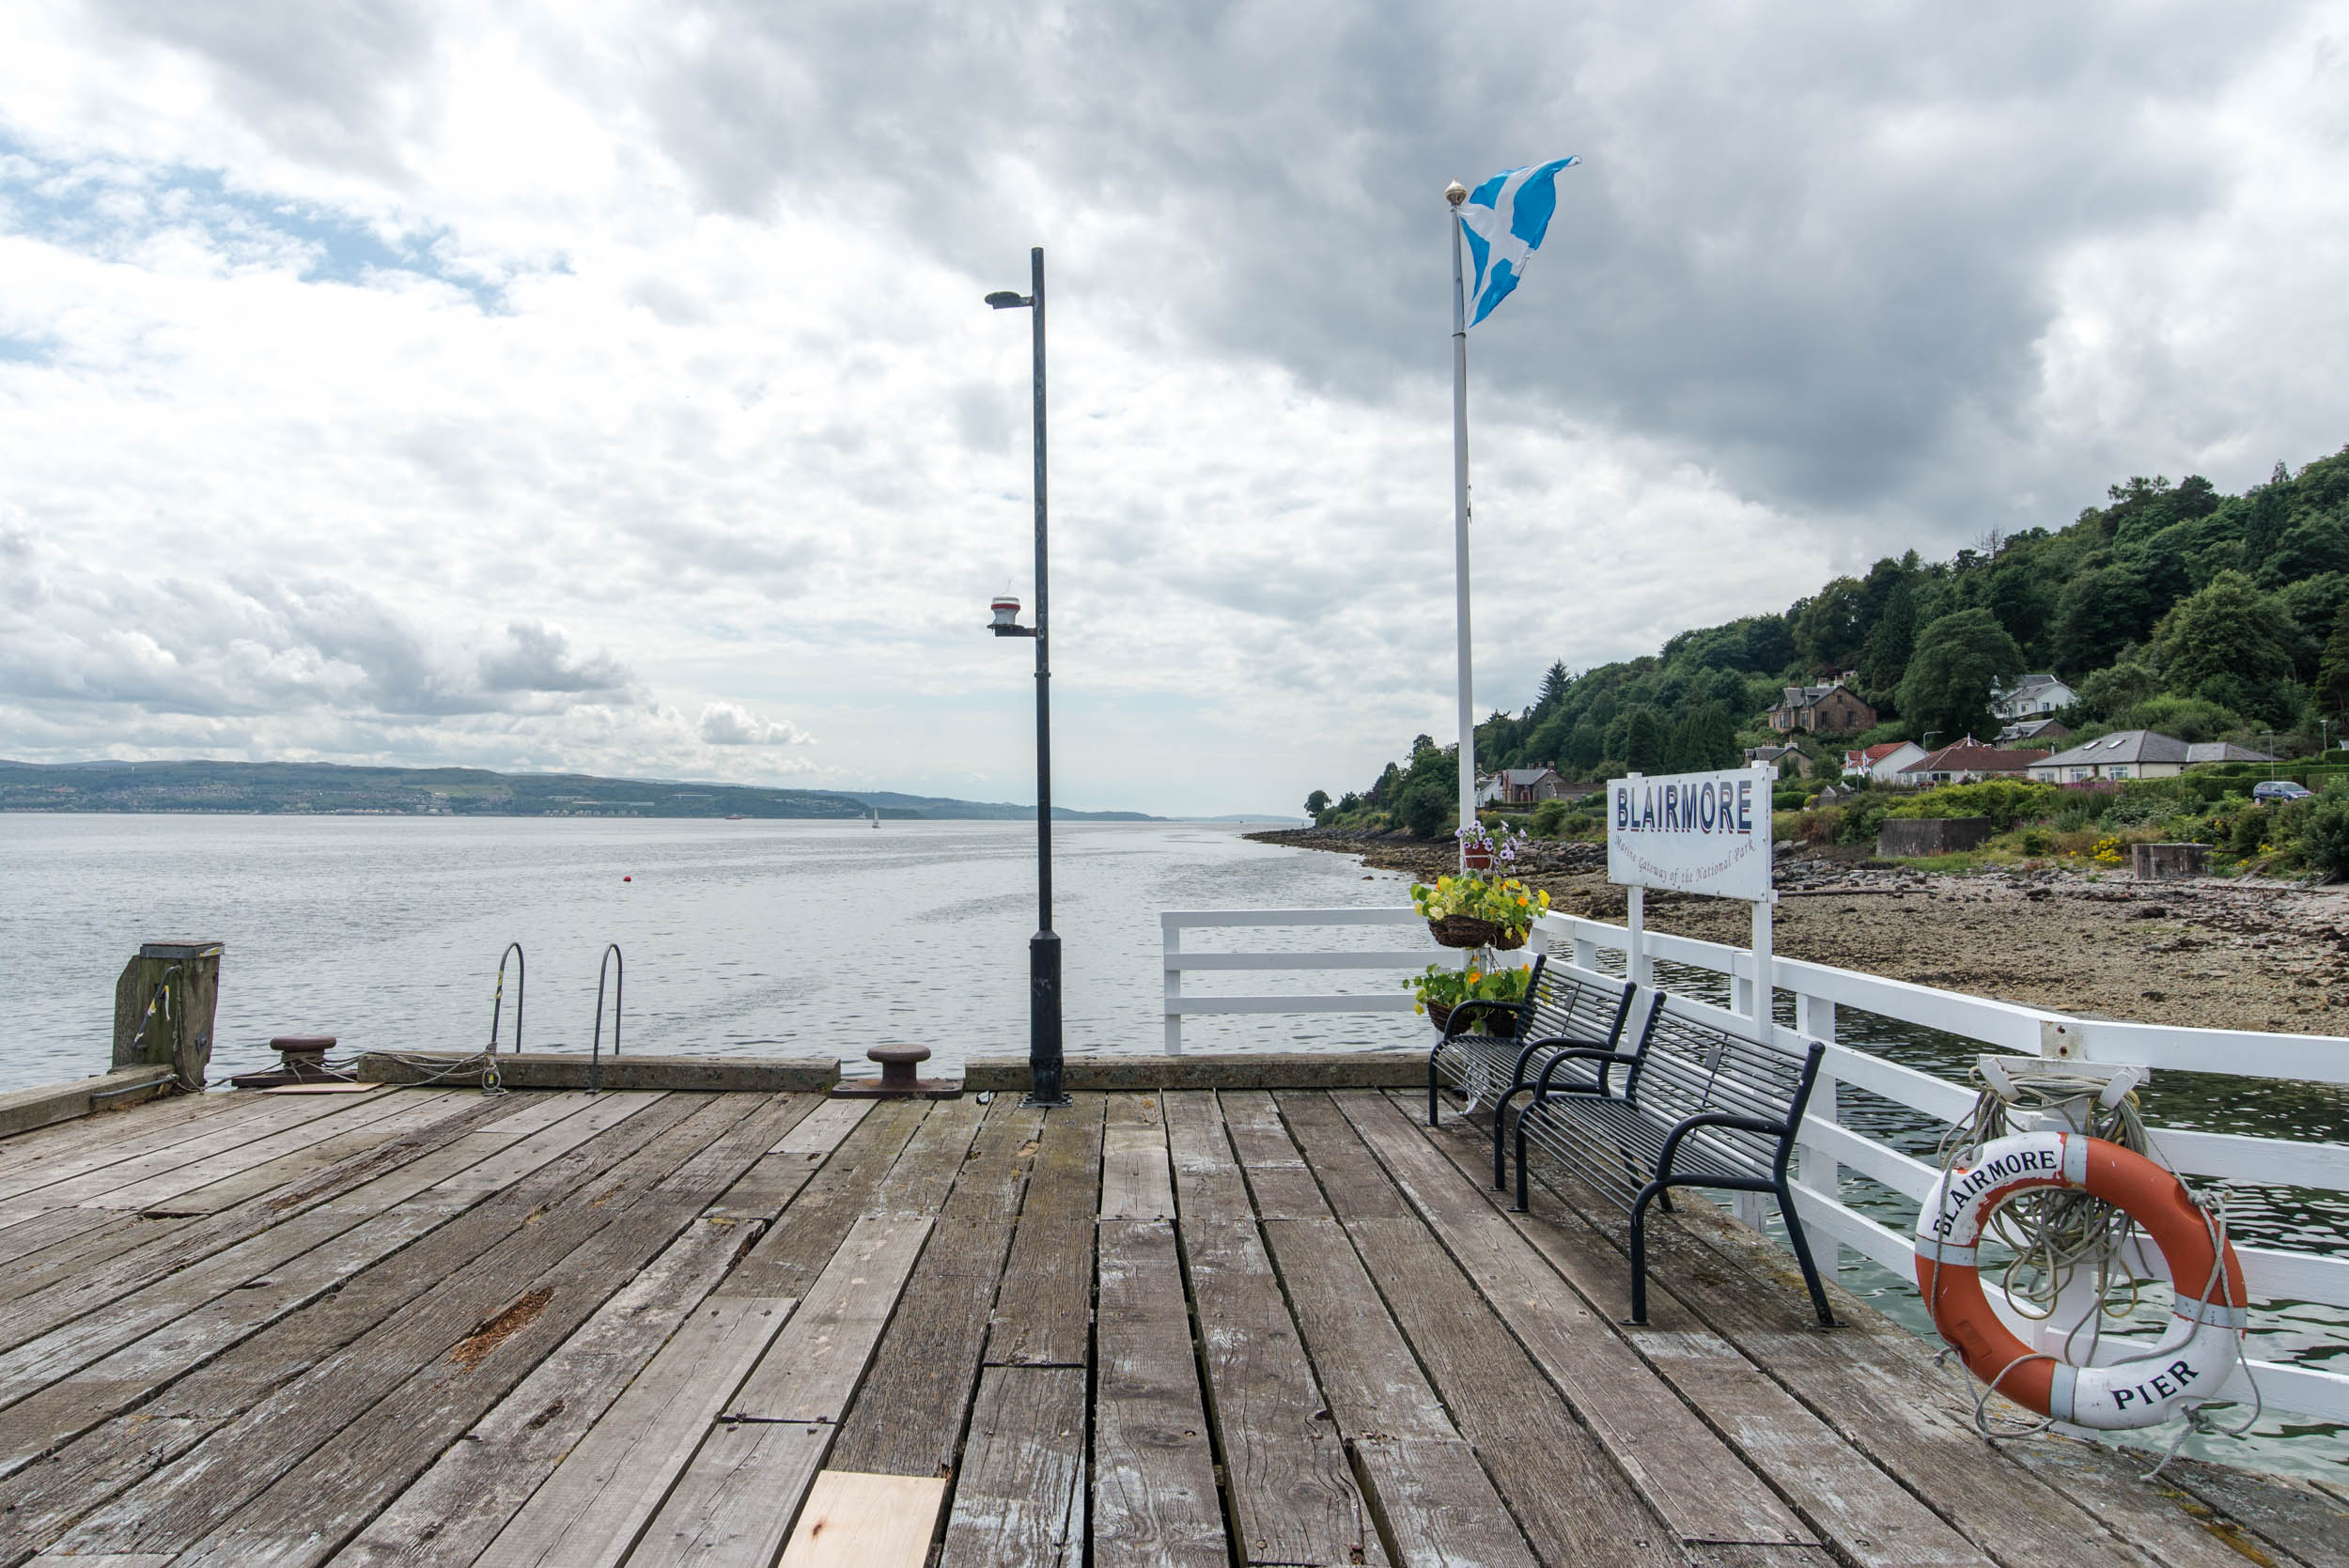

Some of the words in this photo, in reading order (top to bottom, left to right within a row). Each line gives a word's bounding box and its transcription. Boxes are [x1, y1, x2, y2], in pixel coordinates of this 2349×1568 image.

[1617, 781, 1752, 834] BLAIRMORE
[1614, 835, 1637, 862] Marine
[1639, 857, 1667, 883] Gateway
[1670, 868, 1679, 886] of
[1681, 870, 1693, 883] the
[1696, 850, 1732, 882] National
[1734, 834, 1756, 862] Park
[1933, 1150, 2058, 1237] BLAIRMORE
[2111, 1359, 2200, 1411] PIER
